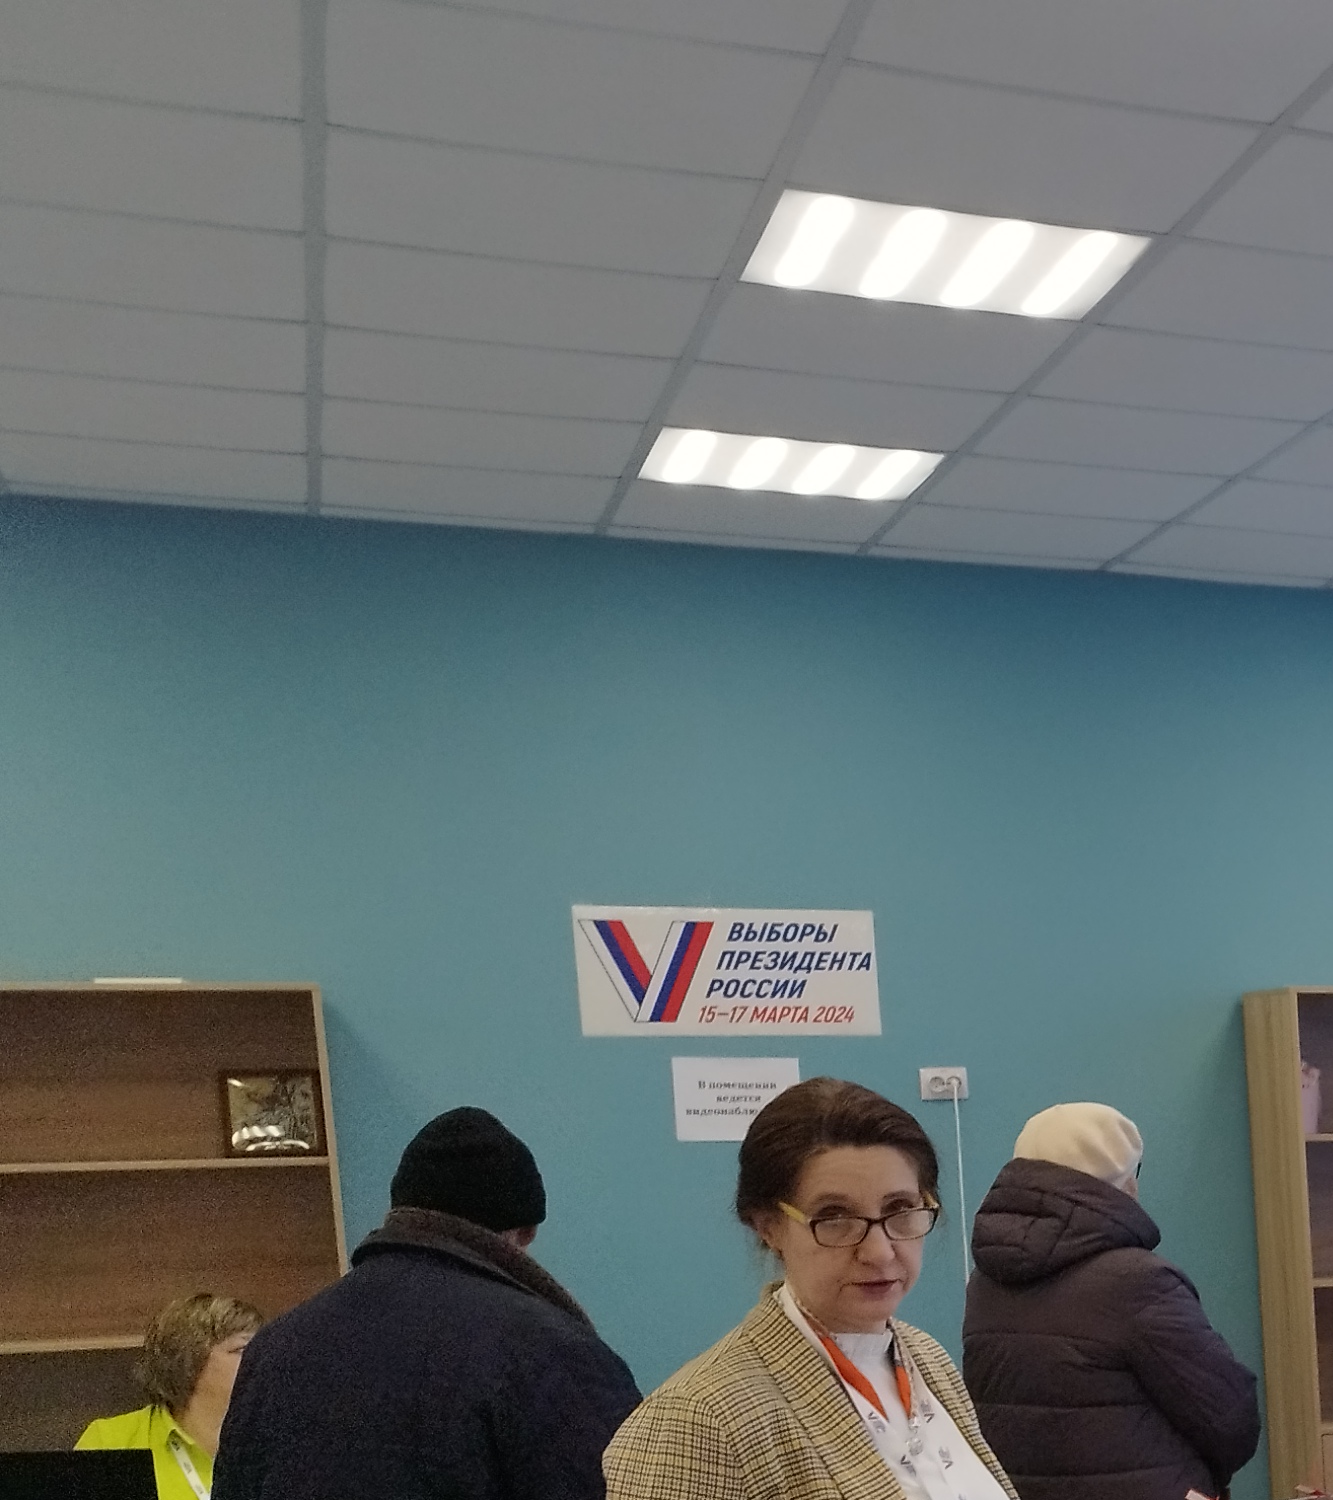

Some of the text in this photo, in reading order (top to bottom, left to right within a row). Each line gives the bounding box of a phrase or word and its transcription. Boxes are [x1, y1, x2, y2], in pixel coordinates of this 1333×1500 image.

[726, 922, 839, 943] ВЫБОРЫ
[716, 950, 872, 974] ПРЕЗИДЕНТА
[705, 978, 808, 999] РОССИИ
[749, 1006, 810, 1023] МАРТА
[812, 1006, 855, 1023] 2024
